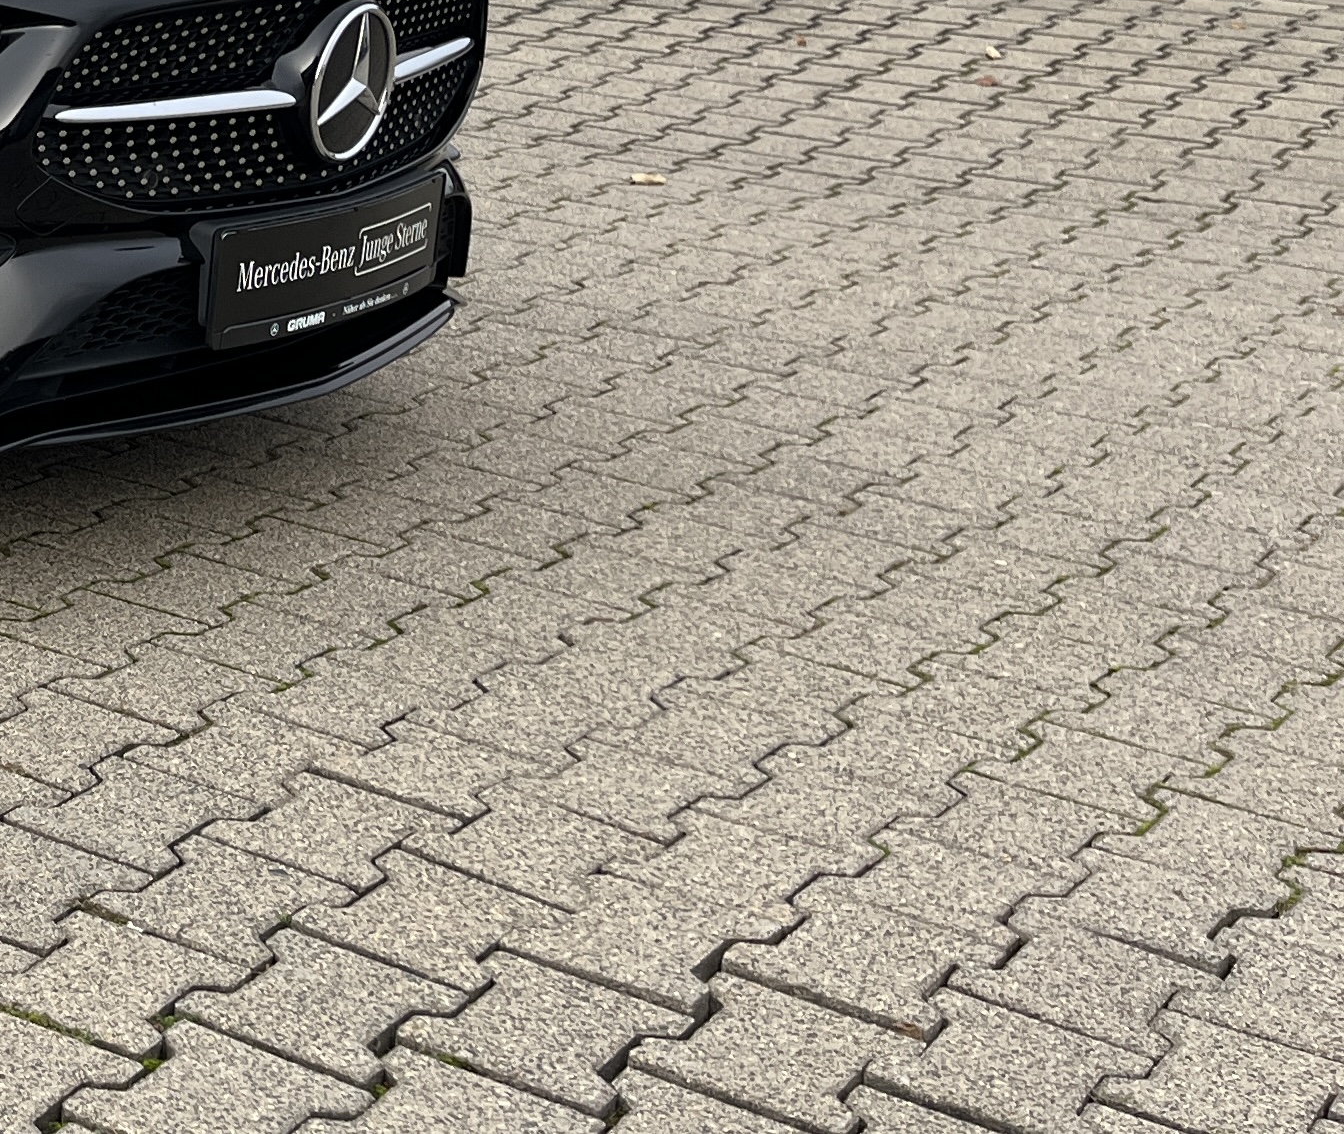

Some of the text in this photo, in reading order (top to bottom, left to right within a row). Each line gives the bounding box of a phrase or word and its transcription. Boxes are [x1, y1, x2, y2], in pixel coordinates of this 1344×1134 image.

[236, 217, 428, 293] Mercedes-Benz Junge Sterne
[286, 311, 326, 333] GRUMA
